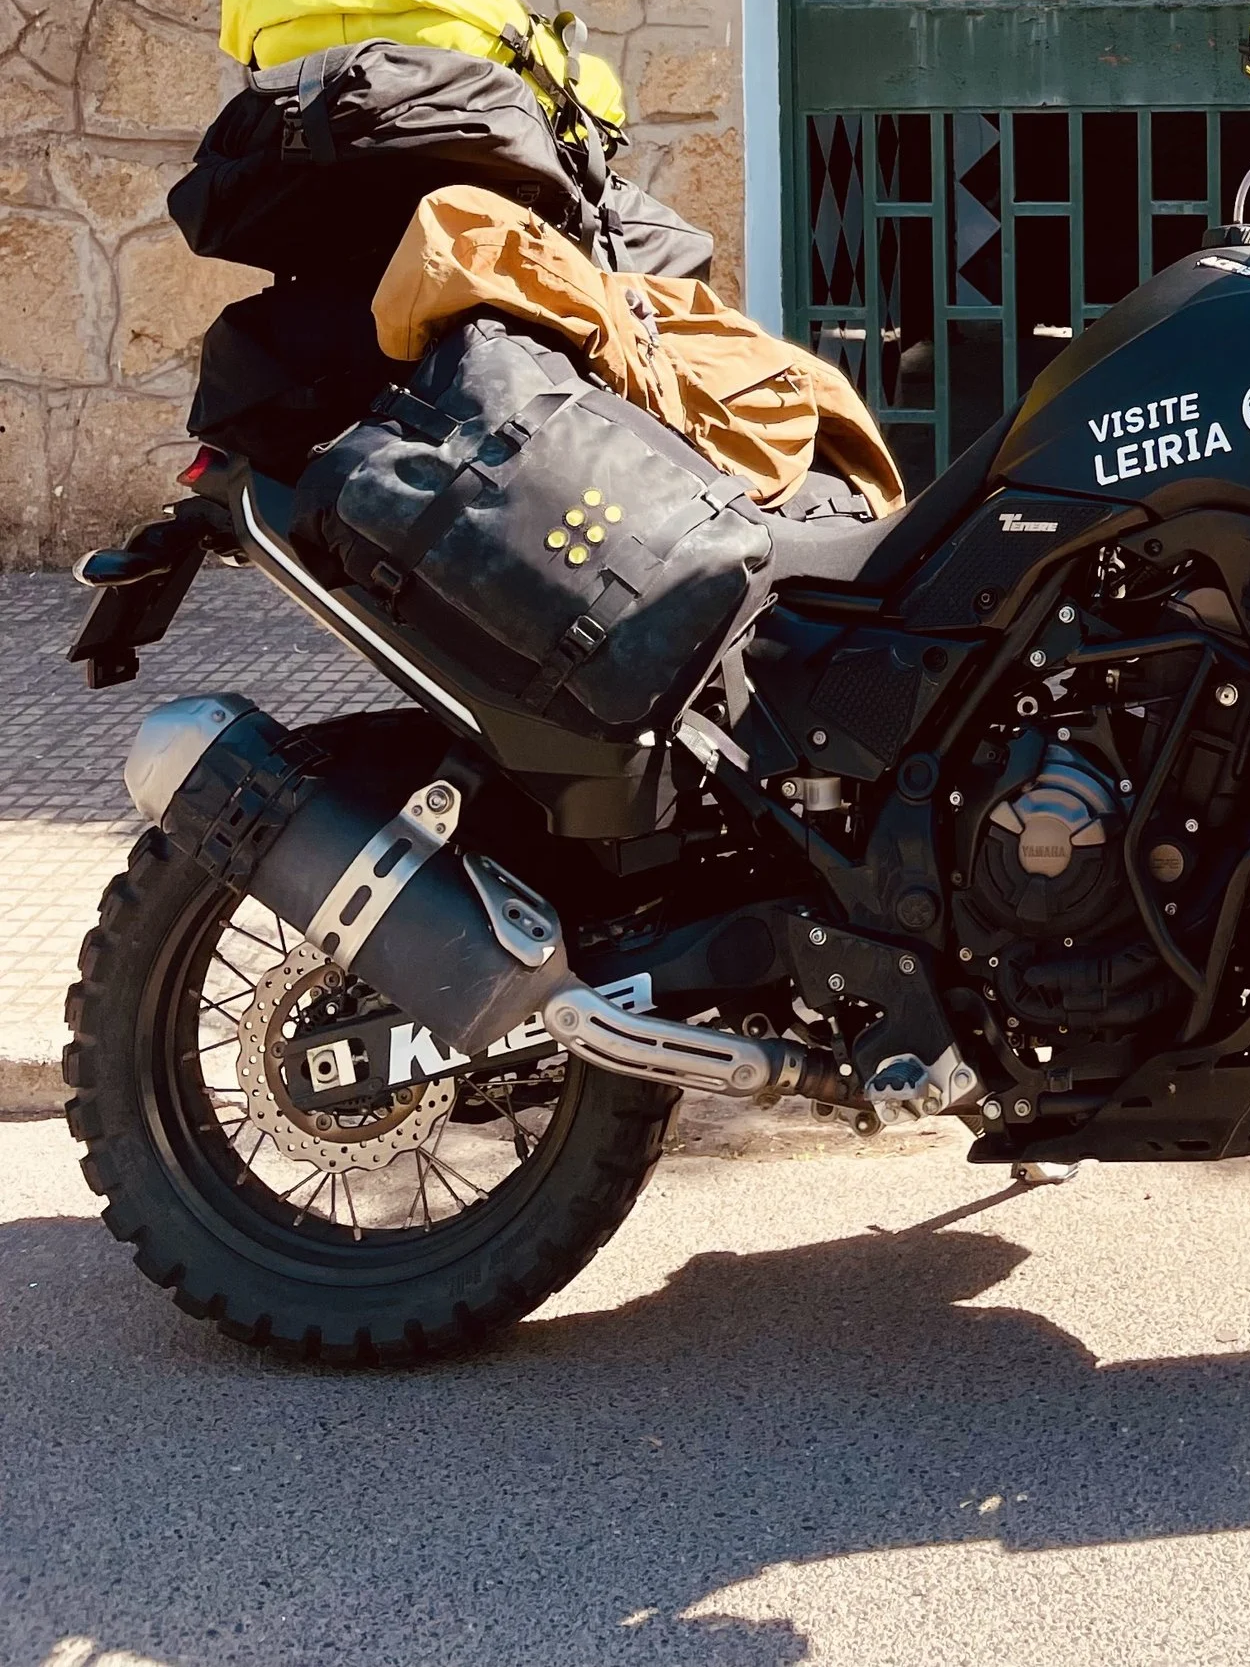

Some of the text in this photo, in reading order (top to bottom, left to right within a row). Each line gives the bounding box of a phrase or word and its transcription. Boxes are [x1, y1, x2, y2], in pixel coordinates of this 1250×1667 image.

[1088, 392, 1201, 443] VISITE
[1094, 421, 1232, 487] LEIRIA
[1021, 845, 1067, 858] YAMAHA
